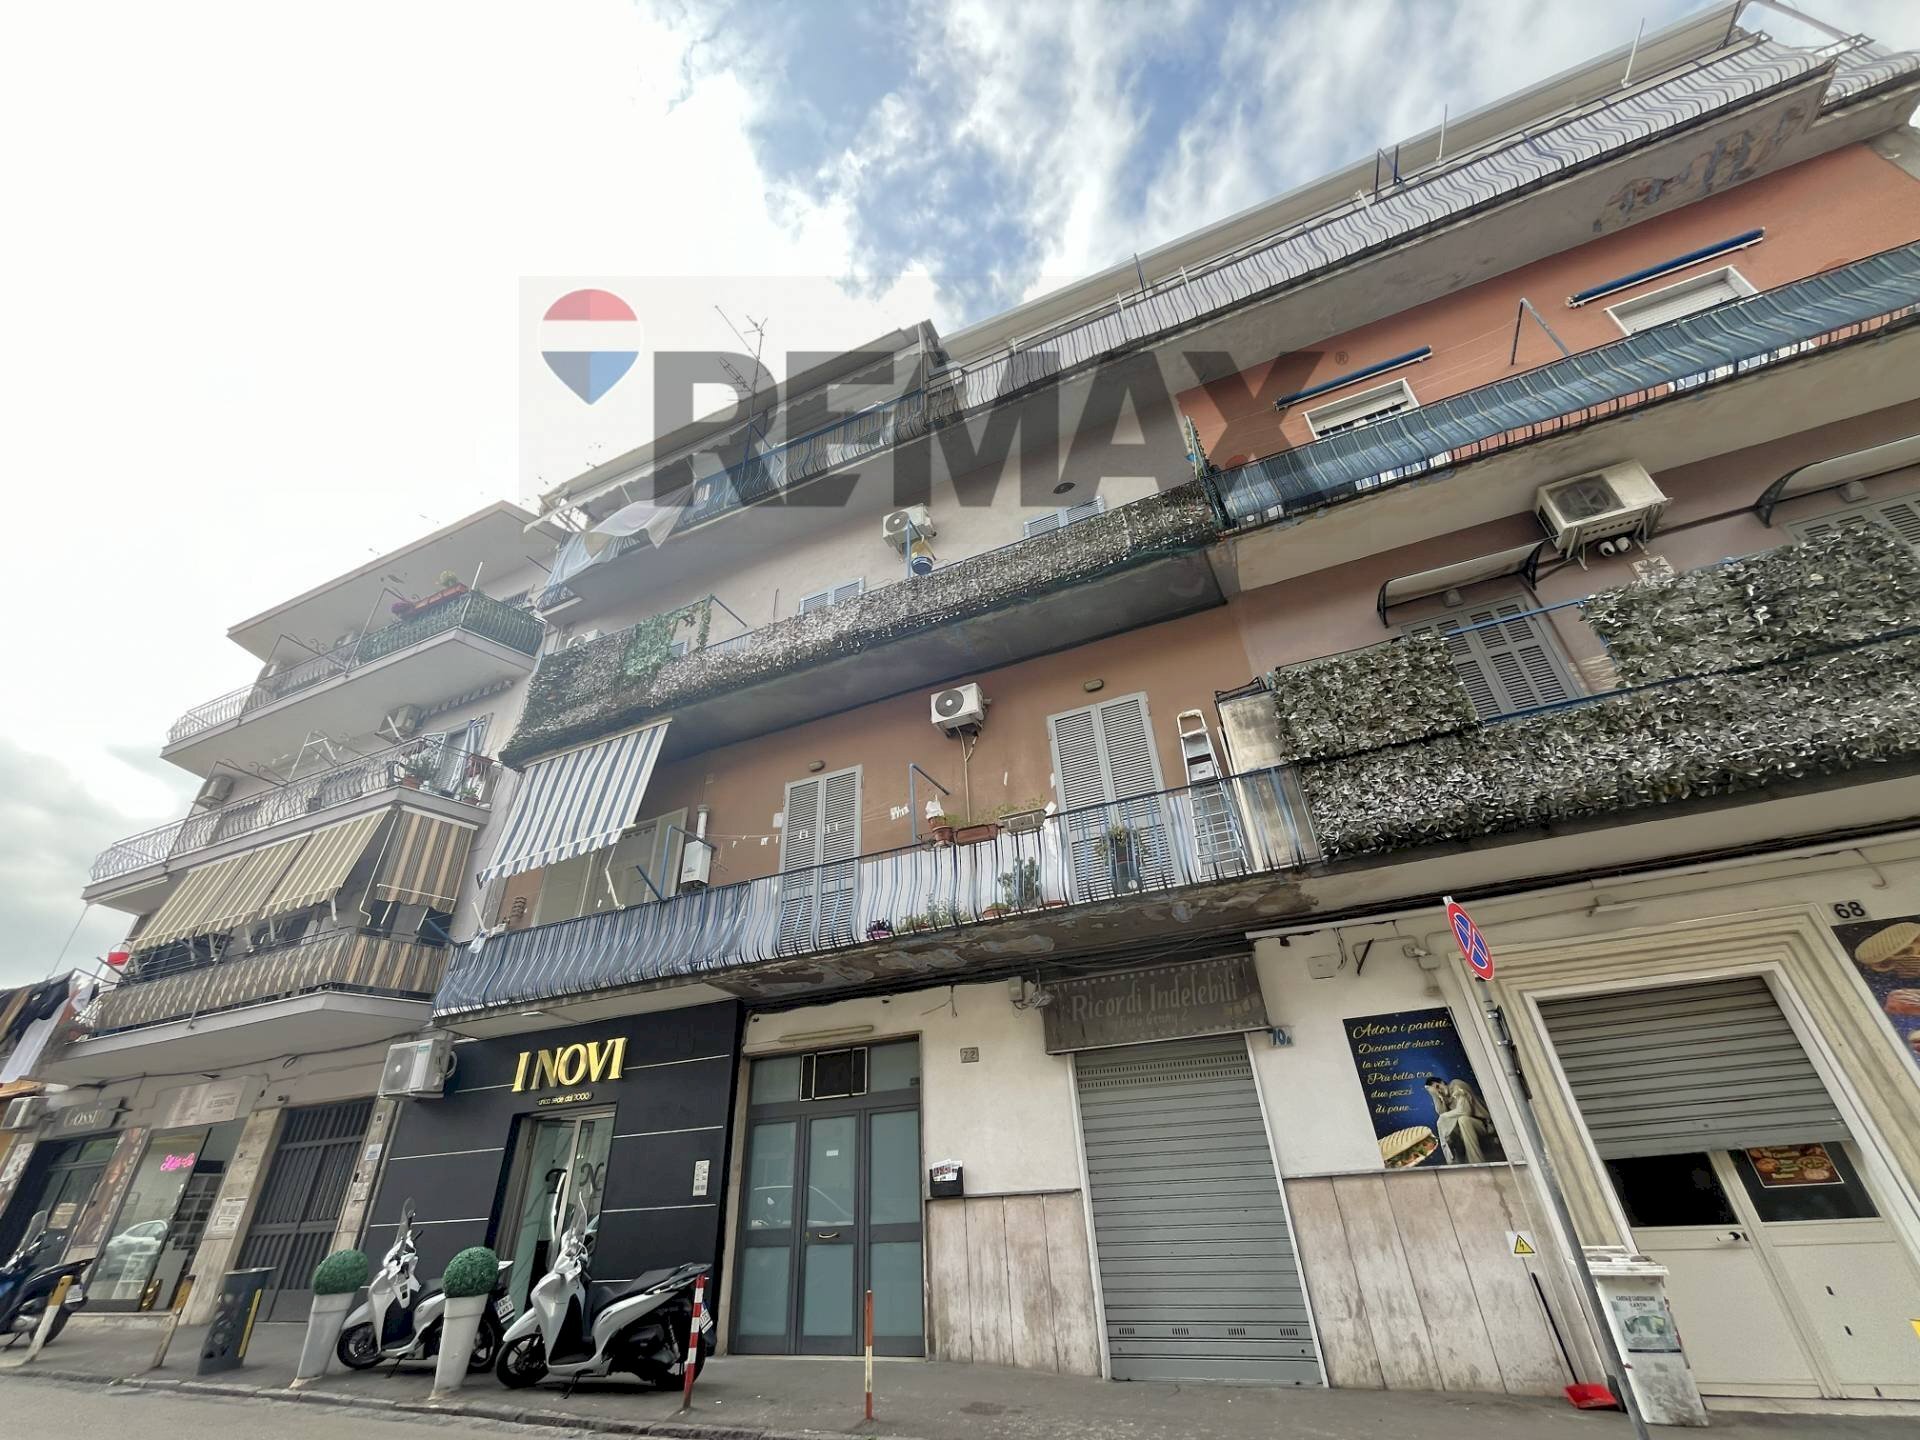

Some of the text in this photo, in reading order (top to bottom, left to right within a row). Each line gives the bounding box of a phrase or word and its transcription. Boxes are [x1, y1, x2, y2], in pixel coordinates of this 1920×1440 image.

[1834, 901, 1866, 919] 68
[1071, 966, 1238, 1021] Ricordi Indelebili
[1353, 1023, 1398, 1039] Adoro
[1400, 1023, 1406, 1032] i
[1358, 1041, 1411, 1054] Diciamolo
[962, 1050, 976, 1061] 72
[511, 1037, 628, 1093] I NOVI
[1362, 1060, 1373, 1069] la
[1392, 1071, 1416, 1081] bella
[1371, 1089, 1388, 1098] due
[1375, 1104, 1386, 1114] di
